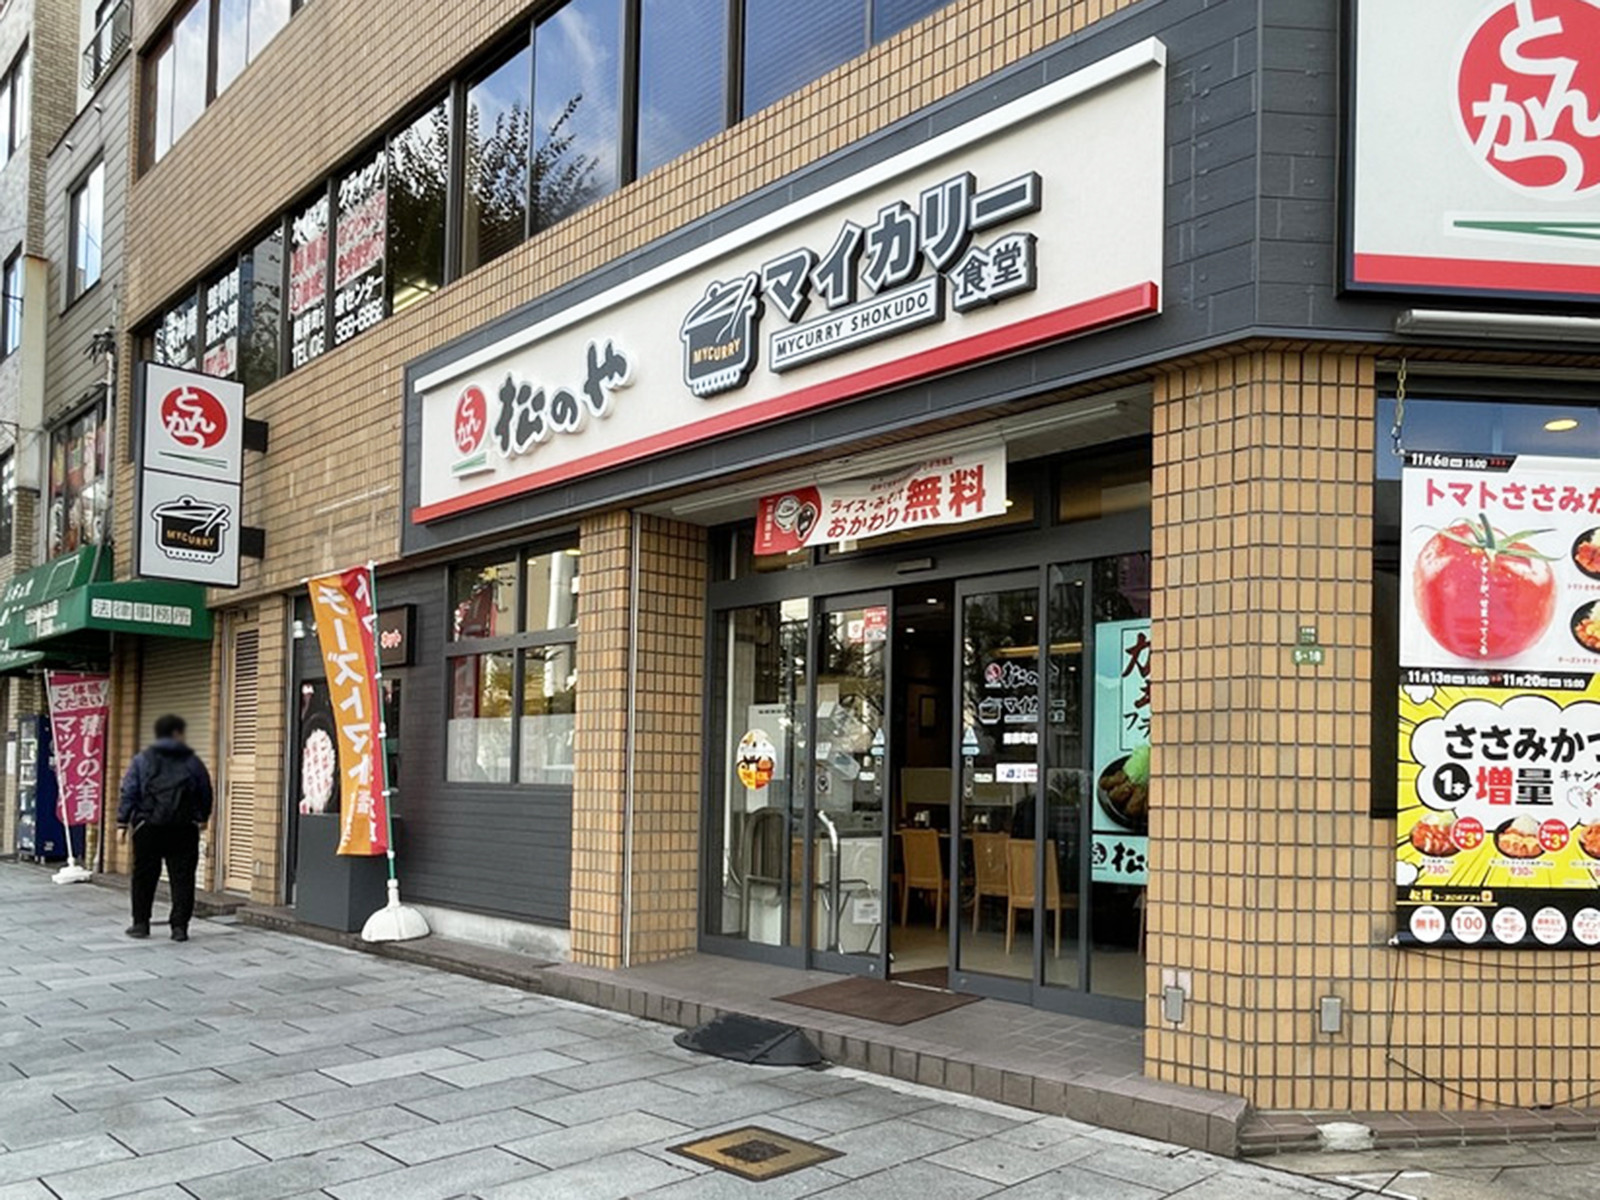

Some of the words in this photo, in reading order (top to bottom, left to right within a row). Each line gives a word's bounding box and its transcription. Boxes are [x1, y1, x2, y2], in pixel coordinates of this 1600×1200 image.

[764, 175, 1033, 316] マイカリー
[957, 241, 1024, 300] 食堂
[692, 337, 742, 364] MYCURRY
[777, 324, 843, 357] MYCURRY
[851, 291, 929, 332] SHOKUDO
[165, 386, 217, 450] とんかつ
[495, 341, 628, 453] 松のや
[827, 508, 899, 538] おかわり
[902, 464, 986, 523] 無料
[166, 528, 217, 548] MYCURRY
[1475, 766, 1555, 806] 増量
